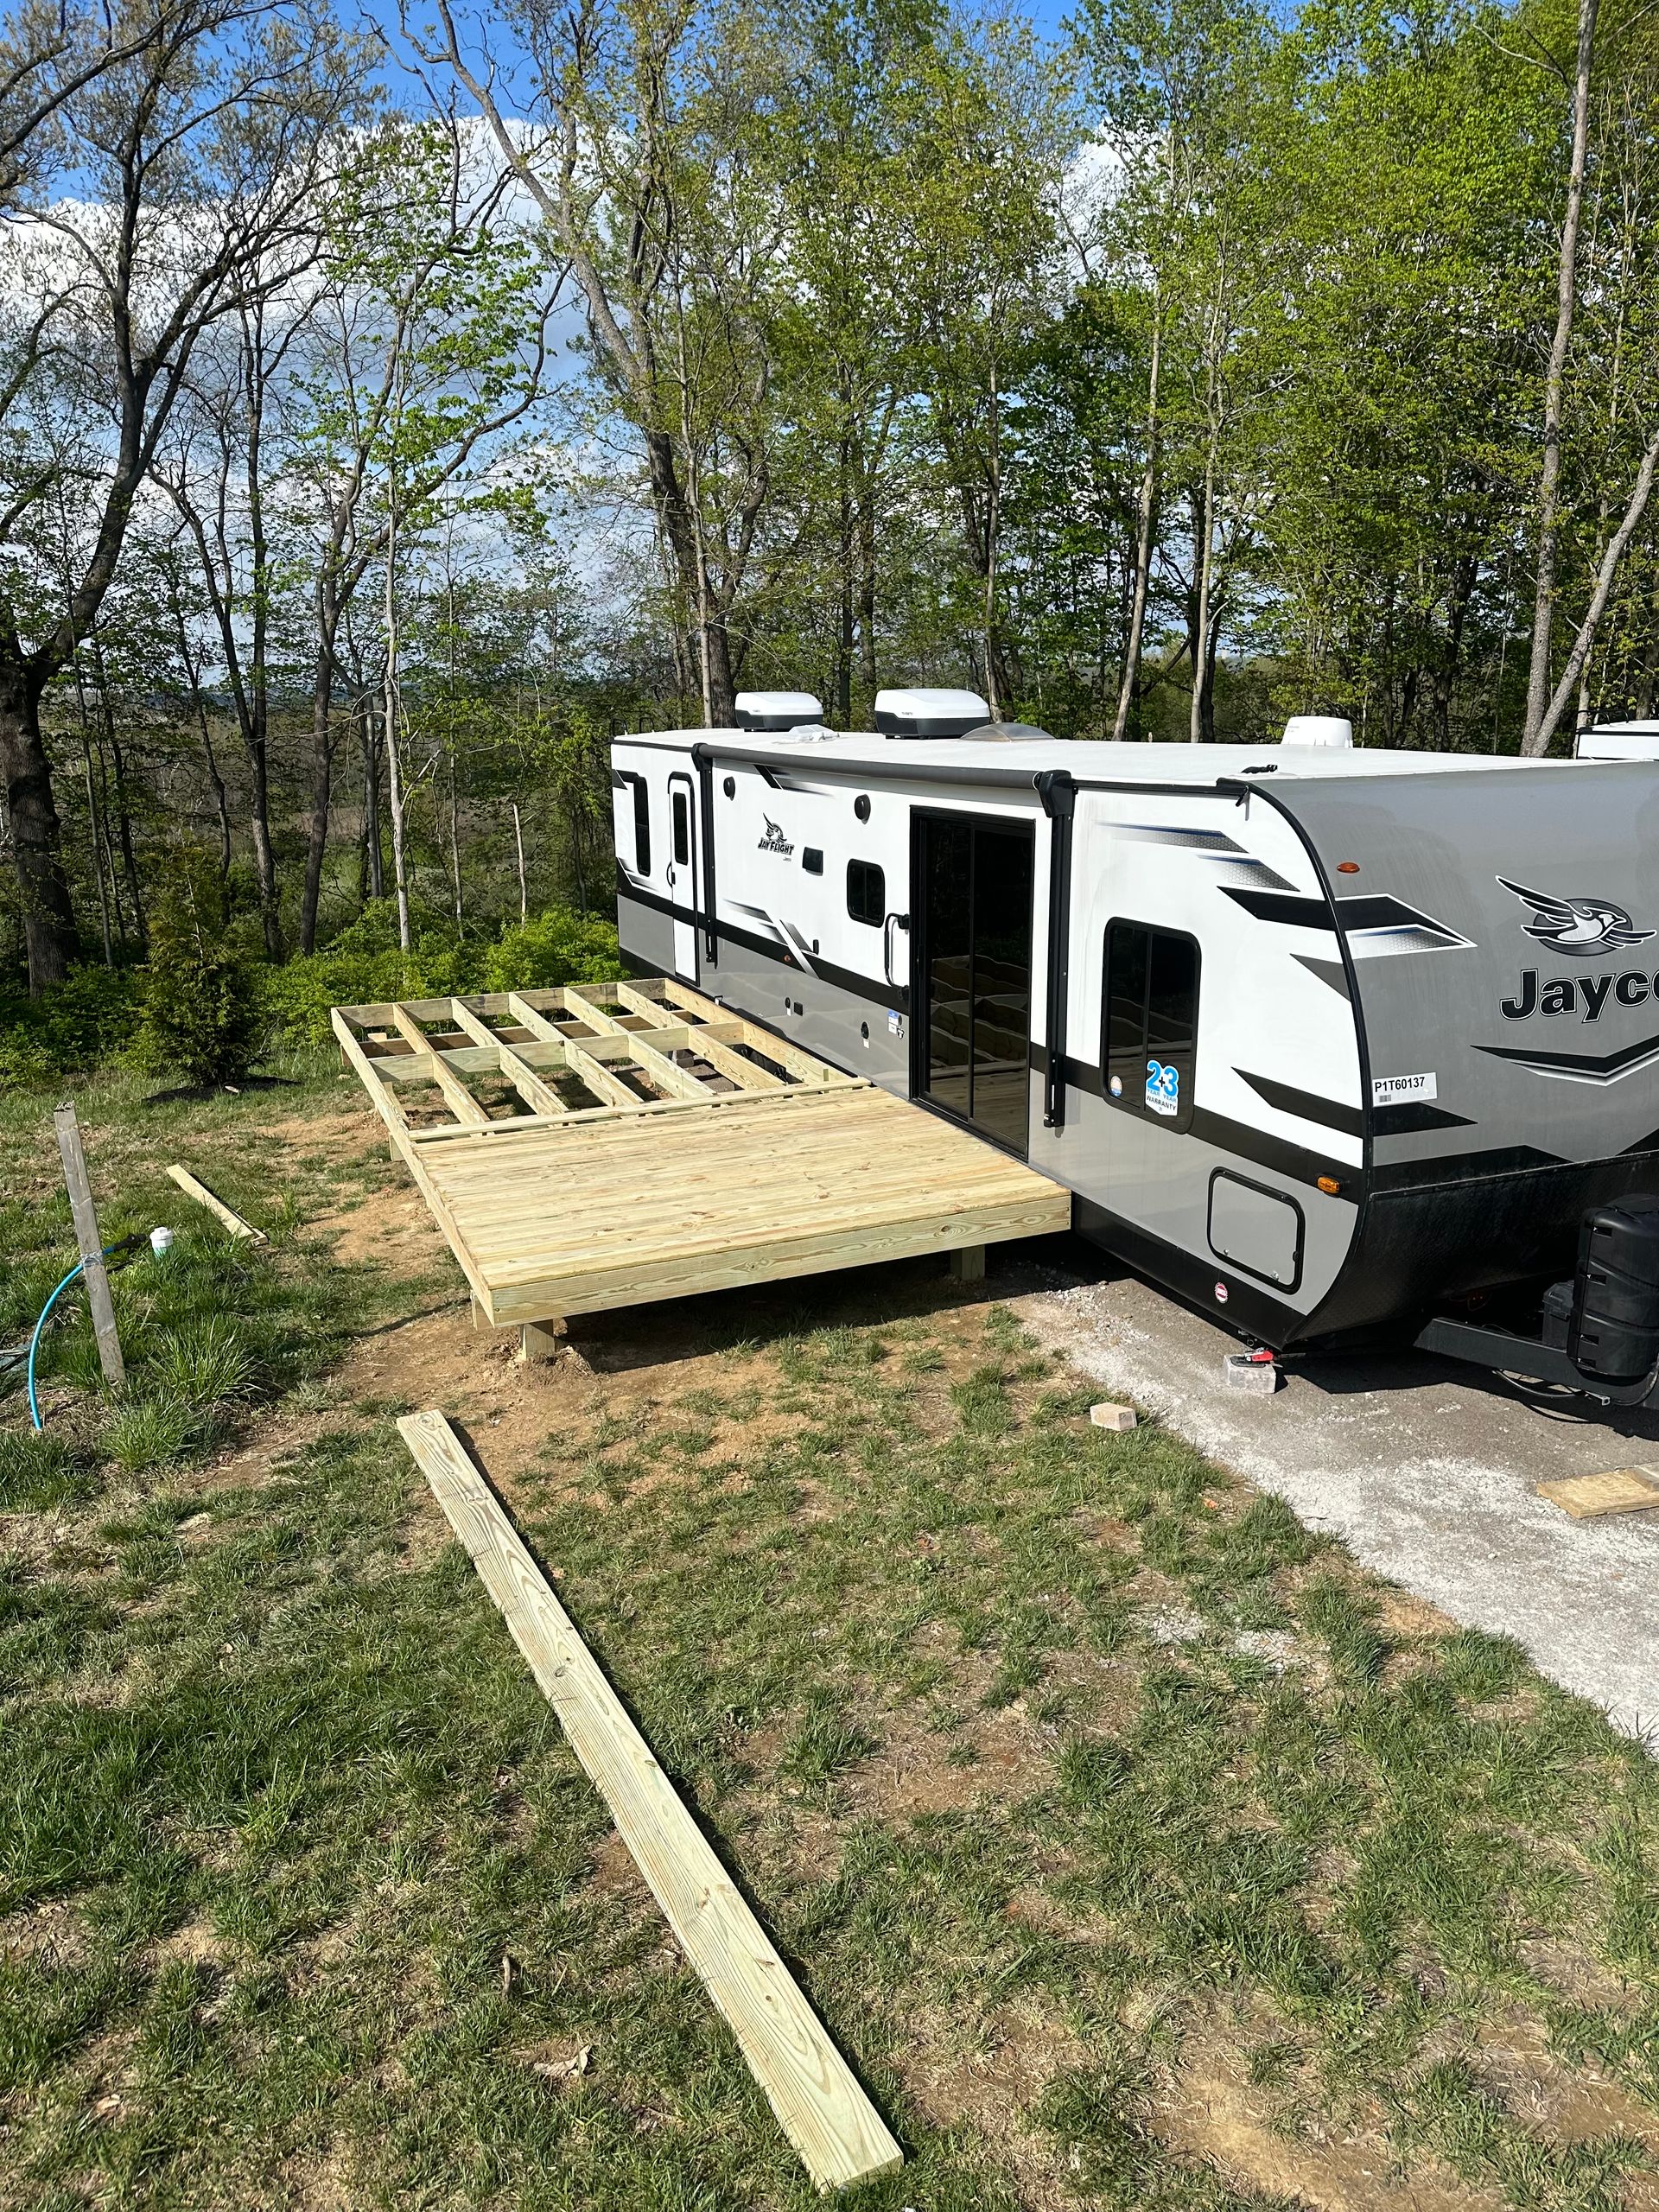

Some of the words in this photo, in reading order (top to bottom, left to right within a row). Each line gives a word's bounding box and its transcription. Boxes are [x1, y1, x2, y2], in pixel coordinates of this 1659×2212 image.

[769, 840, 795, 855] FLIGHT
[1500, 968, 1659, 1023] Jayc
[1375, 1077, 1425, 1092] P1T60137
[1146, 1095, 1176, 1111] WARRANTY
